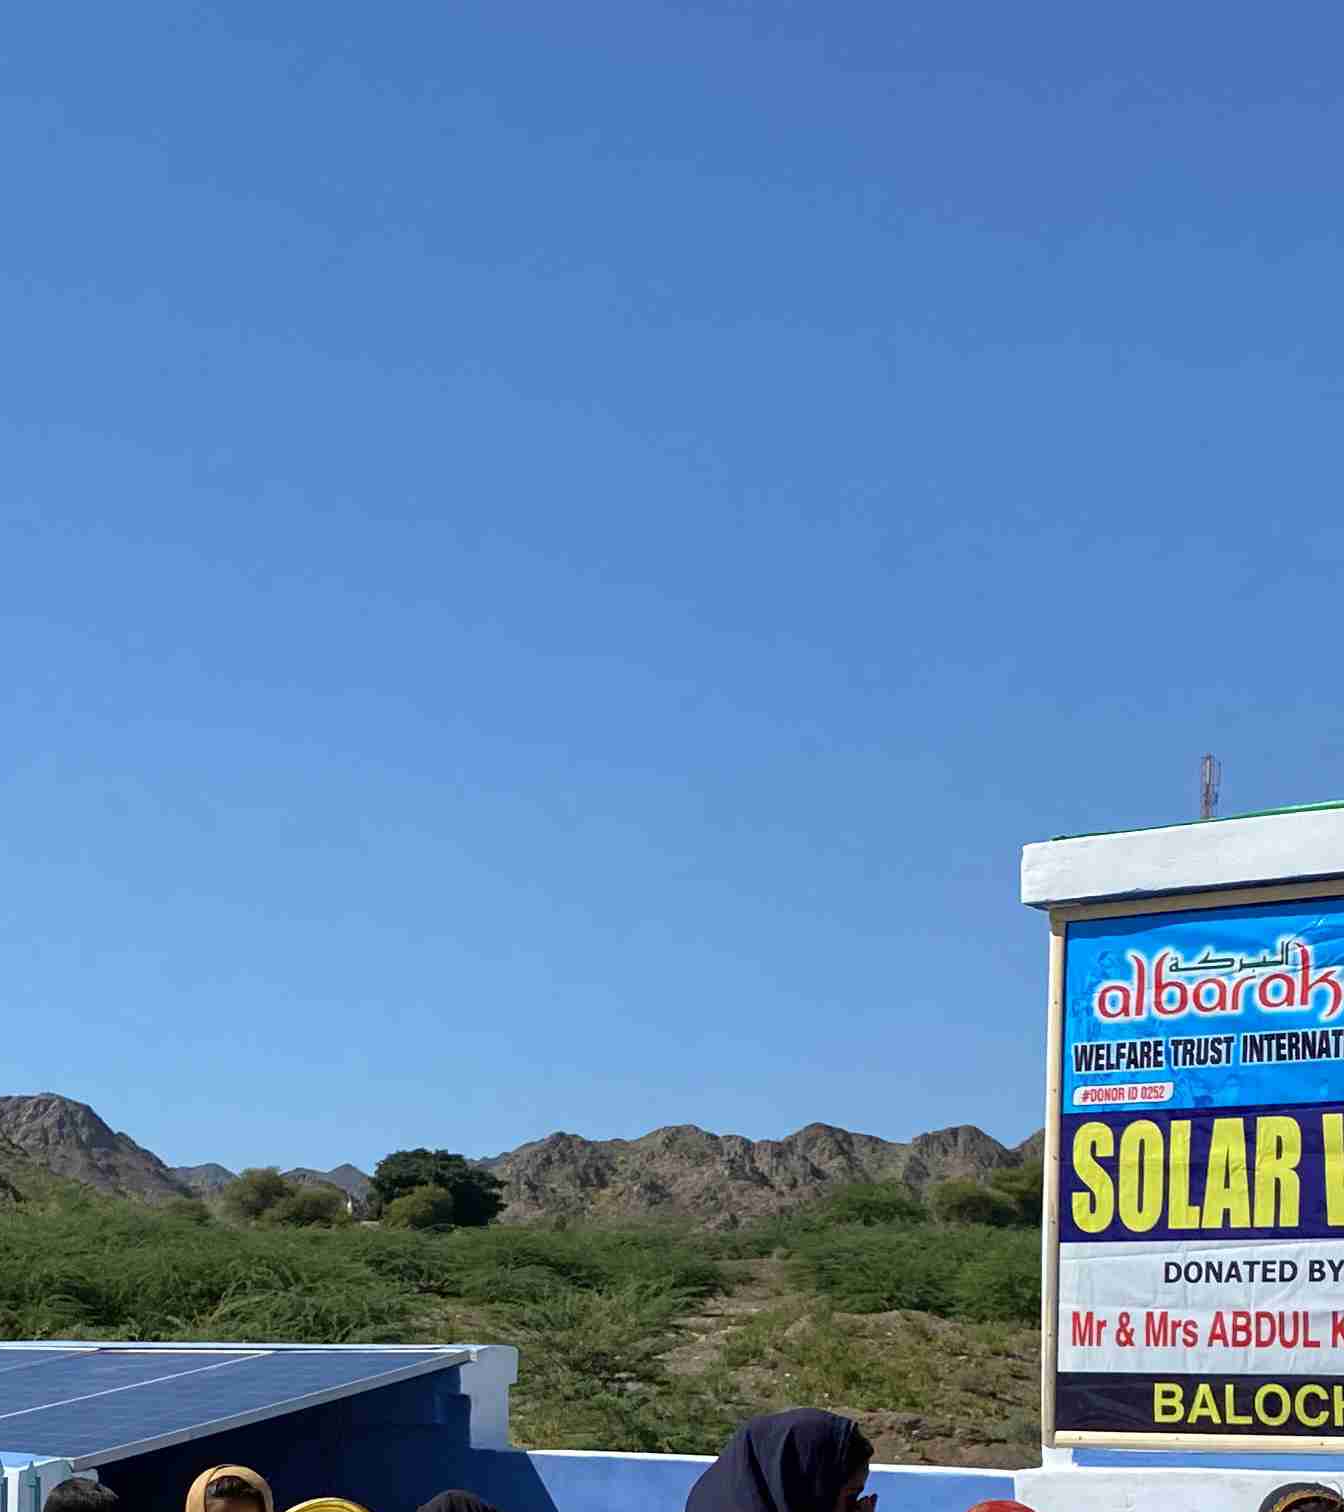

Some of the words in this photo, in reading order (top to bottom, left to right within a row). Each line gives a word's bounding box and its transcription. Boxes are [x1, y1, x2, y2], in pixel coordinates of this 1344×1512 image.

[1073, 1040, 1163, 1072] WELFARE
[1170, 1034, 1235, 1067] TRUST
[1127, 1086, 1138, 1101] ID
[1070, 1115, 1303, 1234] SOLAR
[1163, 1260, 1298, 1284] DONATED
[1071, 1311, 1107, 1347] Mr
[1115, 1311, 1135, 1347] &
[1144, 1311, 1199, 1348] Mrs
[1207, 1310, 1321, 1349] ABDUL
